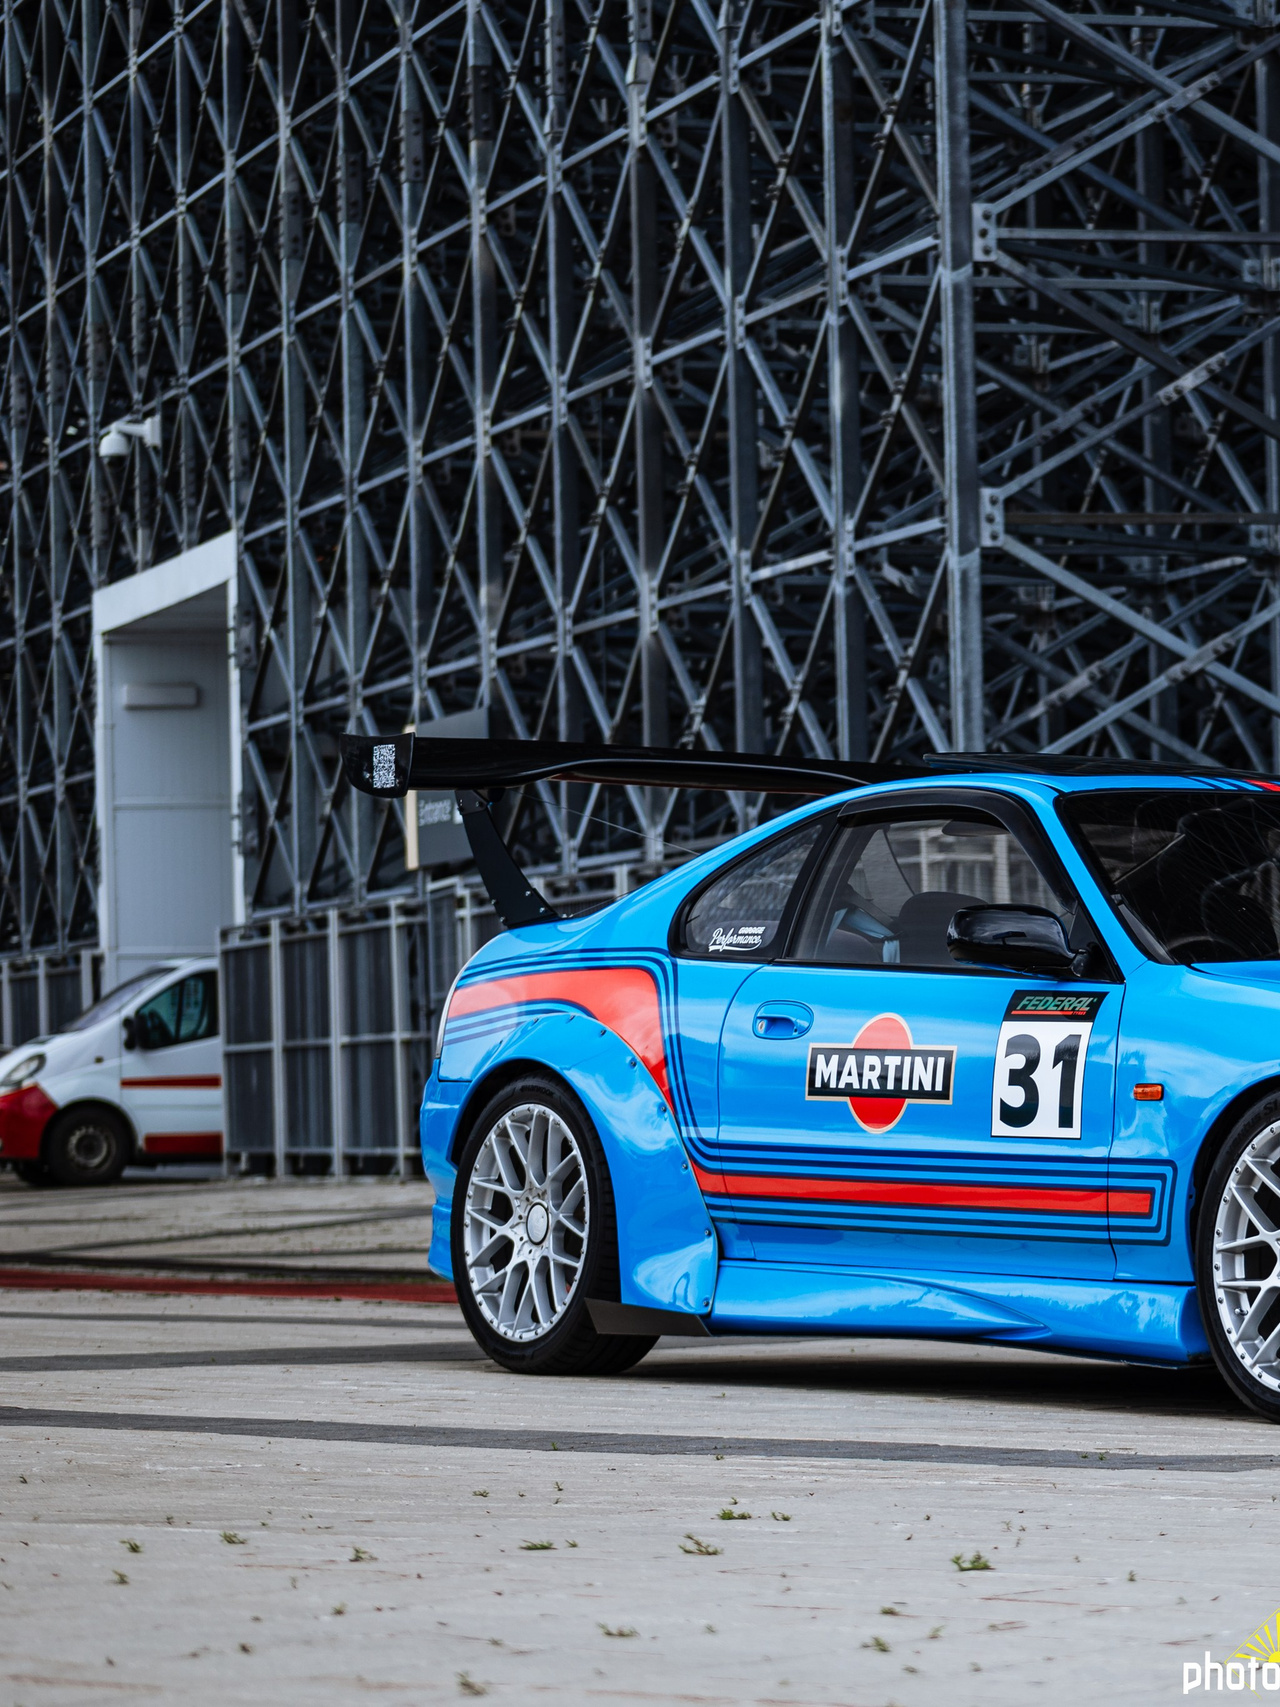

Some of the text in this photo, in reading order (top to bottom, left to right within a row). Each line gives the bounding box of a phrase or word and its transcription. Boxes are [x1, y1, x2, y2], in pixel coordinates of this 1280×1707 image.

[709, 927, 762, 952] Performance
[1016, 996, 1093, 1011] FEDERAL
[814, 1054, 946, 1092] MARTINI
[1000, 1034, 1082, 1128] 31
